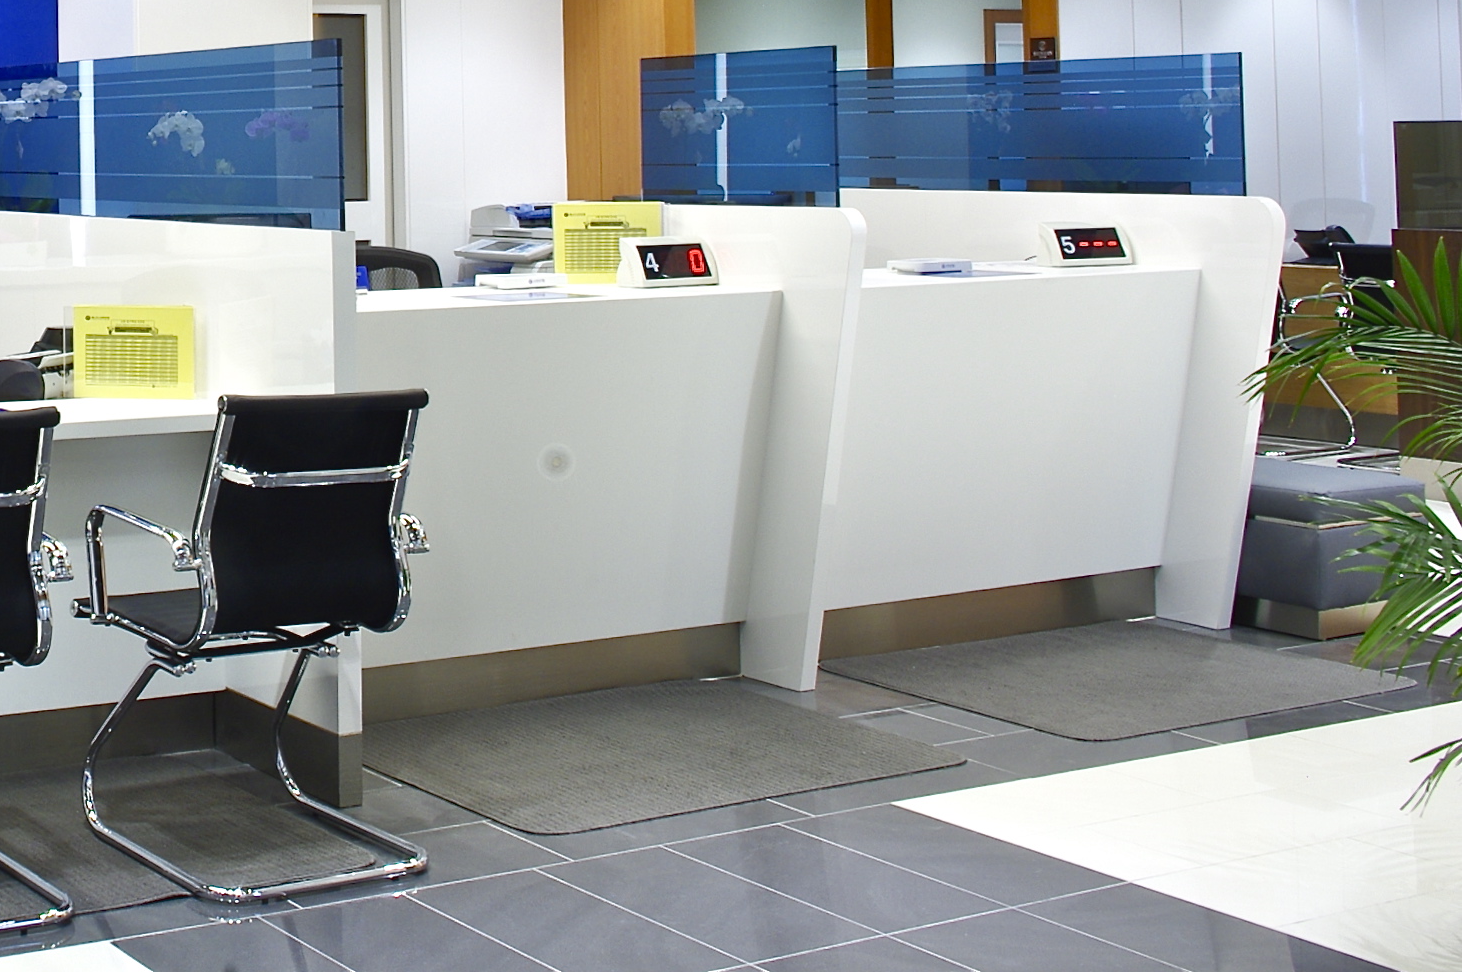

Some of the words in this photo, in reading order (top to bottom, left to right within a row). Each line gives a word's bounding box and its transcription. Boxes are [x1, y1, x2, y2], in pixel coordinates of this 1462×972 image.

[1059, 235, 1076, 255] 5
[645, 252, 659, 272] 4
[688, 248, 706, 273] 0
